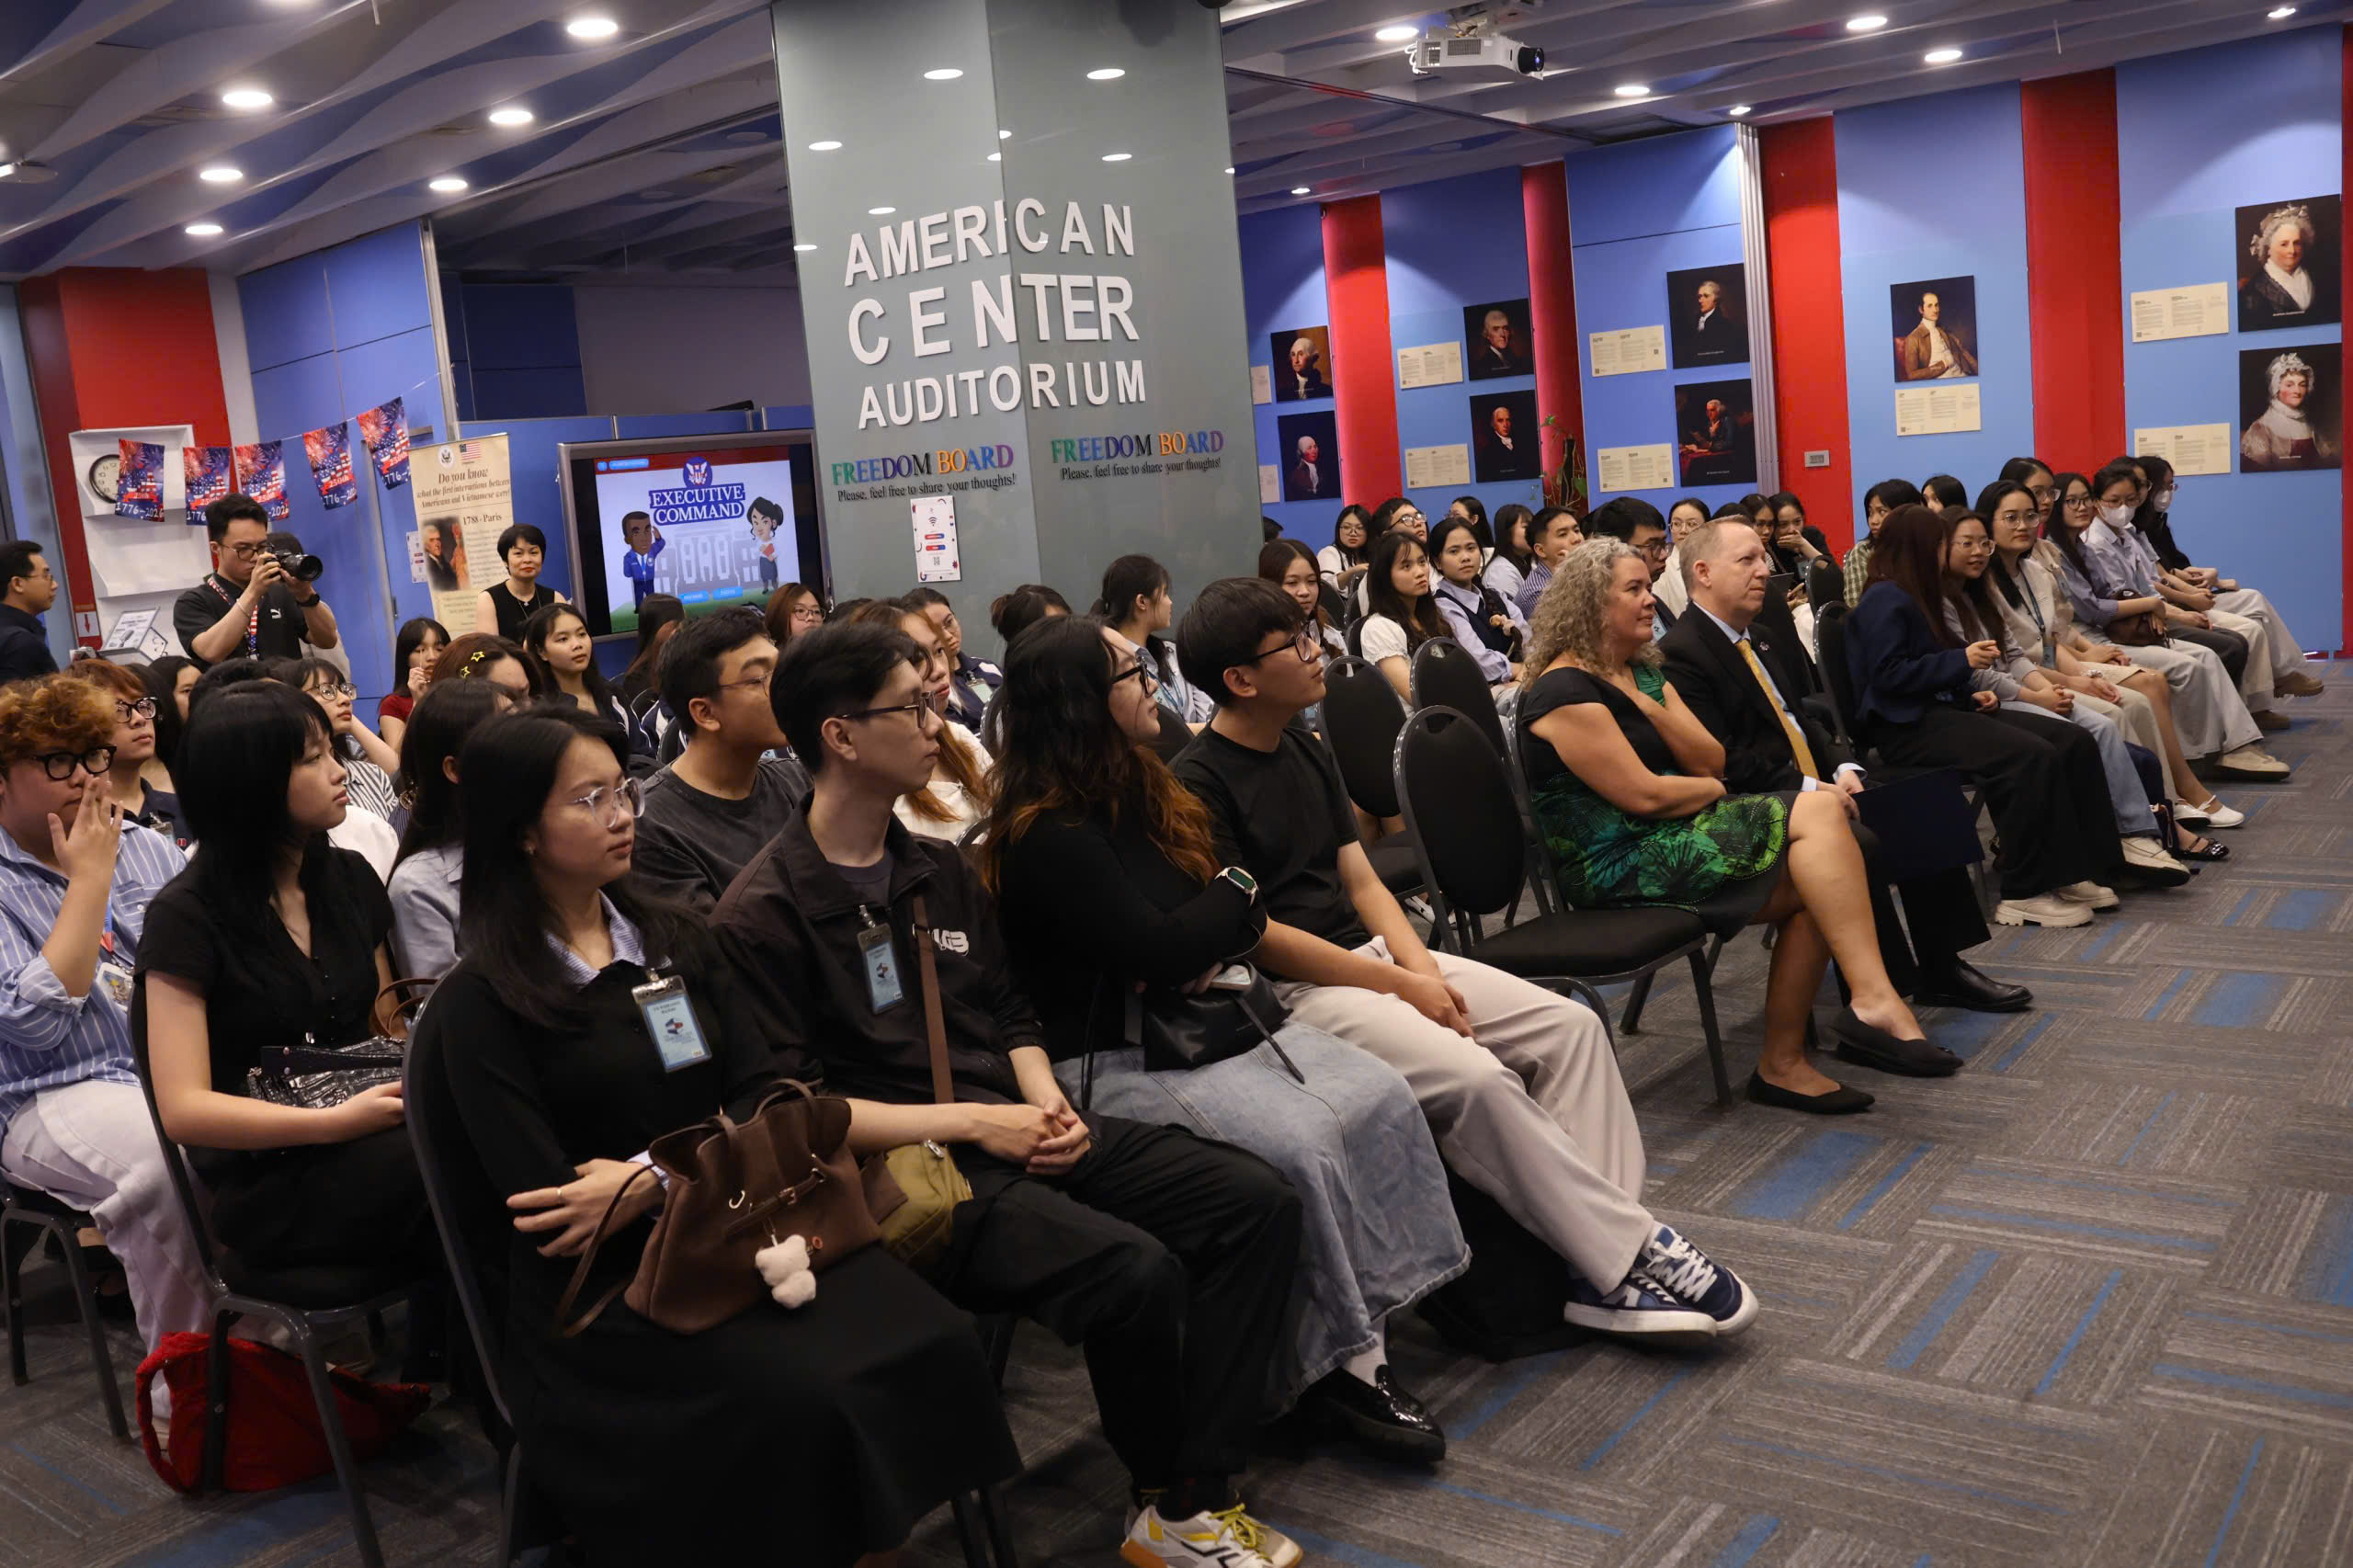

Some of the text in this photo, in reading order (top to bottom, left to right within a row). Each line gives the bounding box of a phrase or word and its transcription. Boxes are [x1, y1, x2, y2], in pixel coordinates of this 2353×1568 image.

[844, 198, 1134, 287] AMERICAN
[847, 273, 1139, 365] CENTER
[858, 360, 1146, 429] AUDITORIUM
[1051, 430, 1223, 463] FREEDOM BOARD
[832, 445, 1014, 485] FREEDOM BOARD
[1095, 464, 1110, 477] feel
[1113, 462, 1129, 476] free
[1131, 464, 1140, 474] to
[1142, 461, 1163, 473] share
[1166, 461, 1184, 475] your
[1187, 457, 1222, 472] thoughts!
[438, 469, 488, 484] Do you know
[870, 485, 885, 499] feel
[889, 484, 904, 496] free
[908, 483, 916, 495] to
[919, 481, 942, 494] share
[947, 482, 968, 494] your
[972, 474, 1016, 491] thoughts!
[421, 499, 449, 508] Americans
[462, 492, 494, 502] Vietnamese
[443, 486, 453, 497] first
[653, 485, 743, 506] EXECUTIVE
[483, 514, 502, 522] Paris
[655, 503, 742, 524] COMMAND
